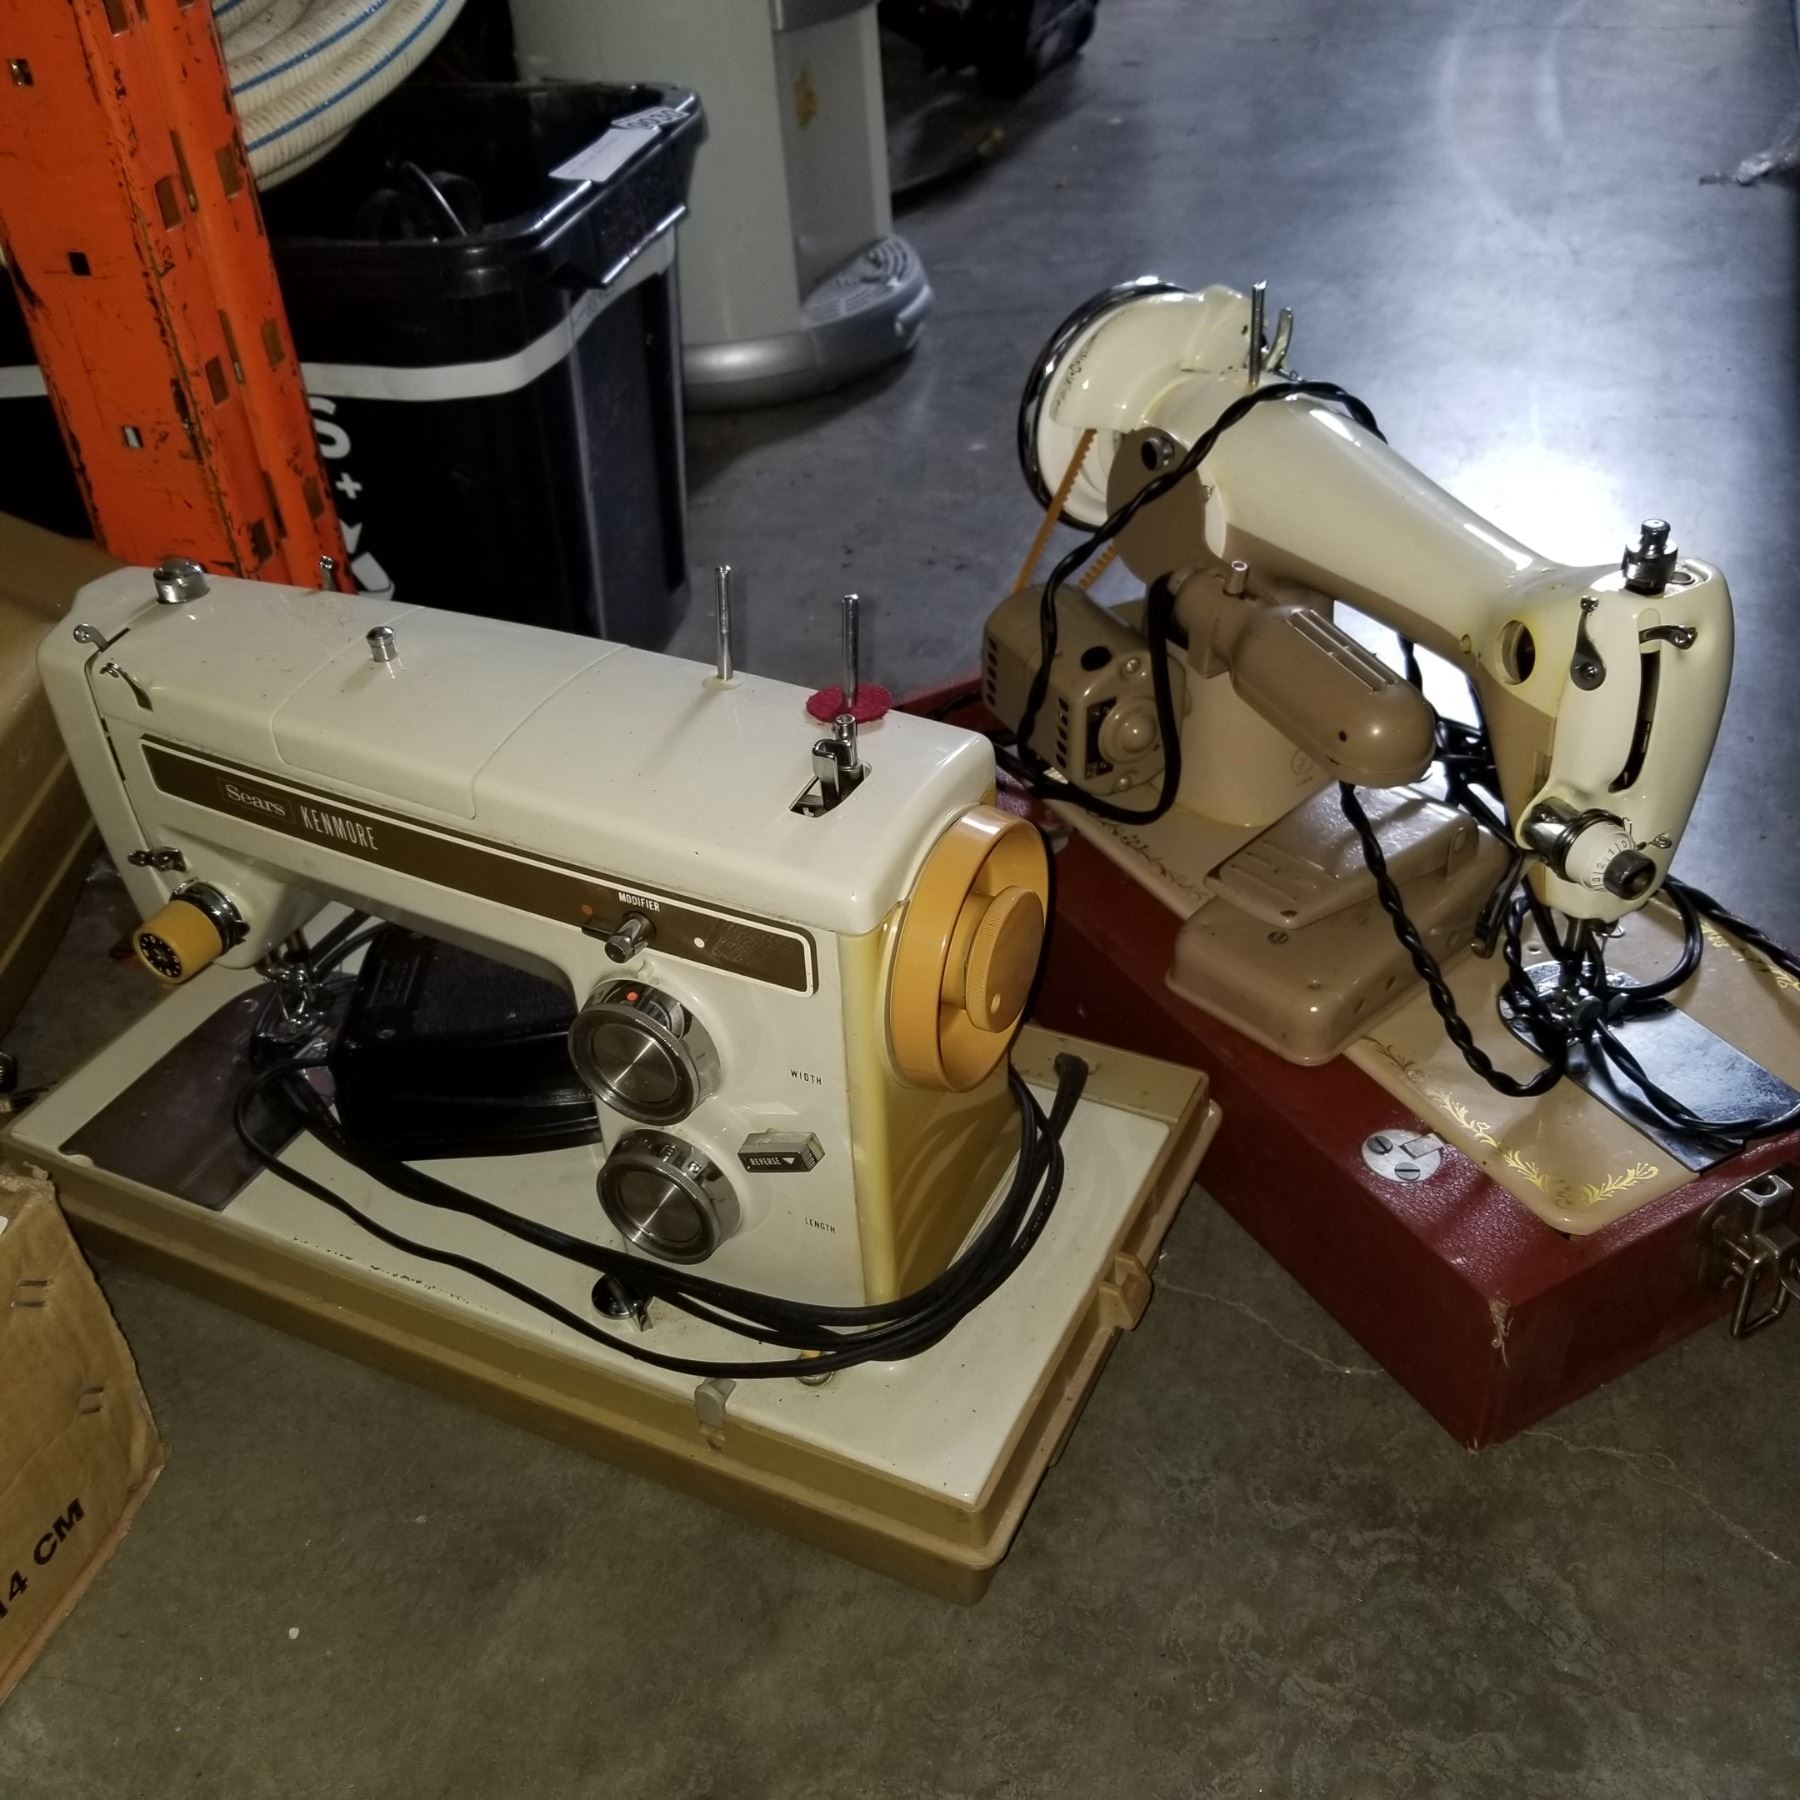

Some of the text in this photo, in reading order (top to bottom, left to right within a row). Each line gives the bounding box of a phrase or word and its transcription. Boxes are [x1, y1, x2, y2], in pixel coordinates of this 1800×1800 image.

[225, 784, 379, 851] Sears KENMORE
[619, 891, 661, 913] MODIFIER
[790, 1068, 822, 1086] WIDTH
[750, 1156, 781, 1167] REVERSE
[804, 1216, 836, 1234] LENGTH
[33, 1497, 84, 1566] CM
